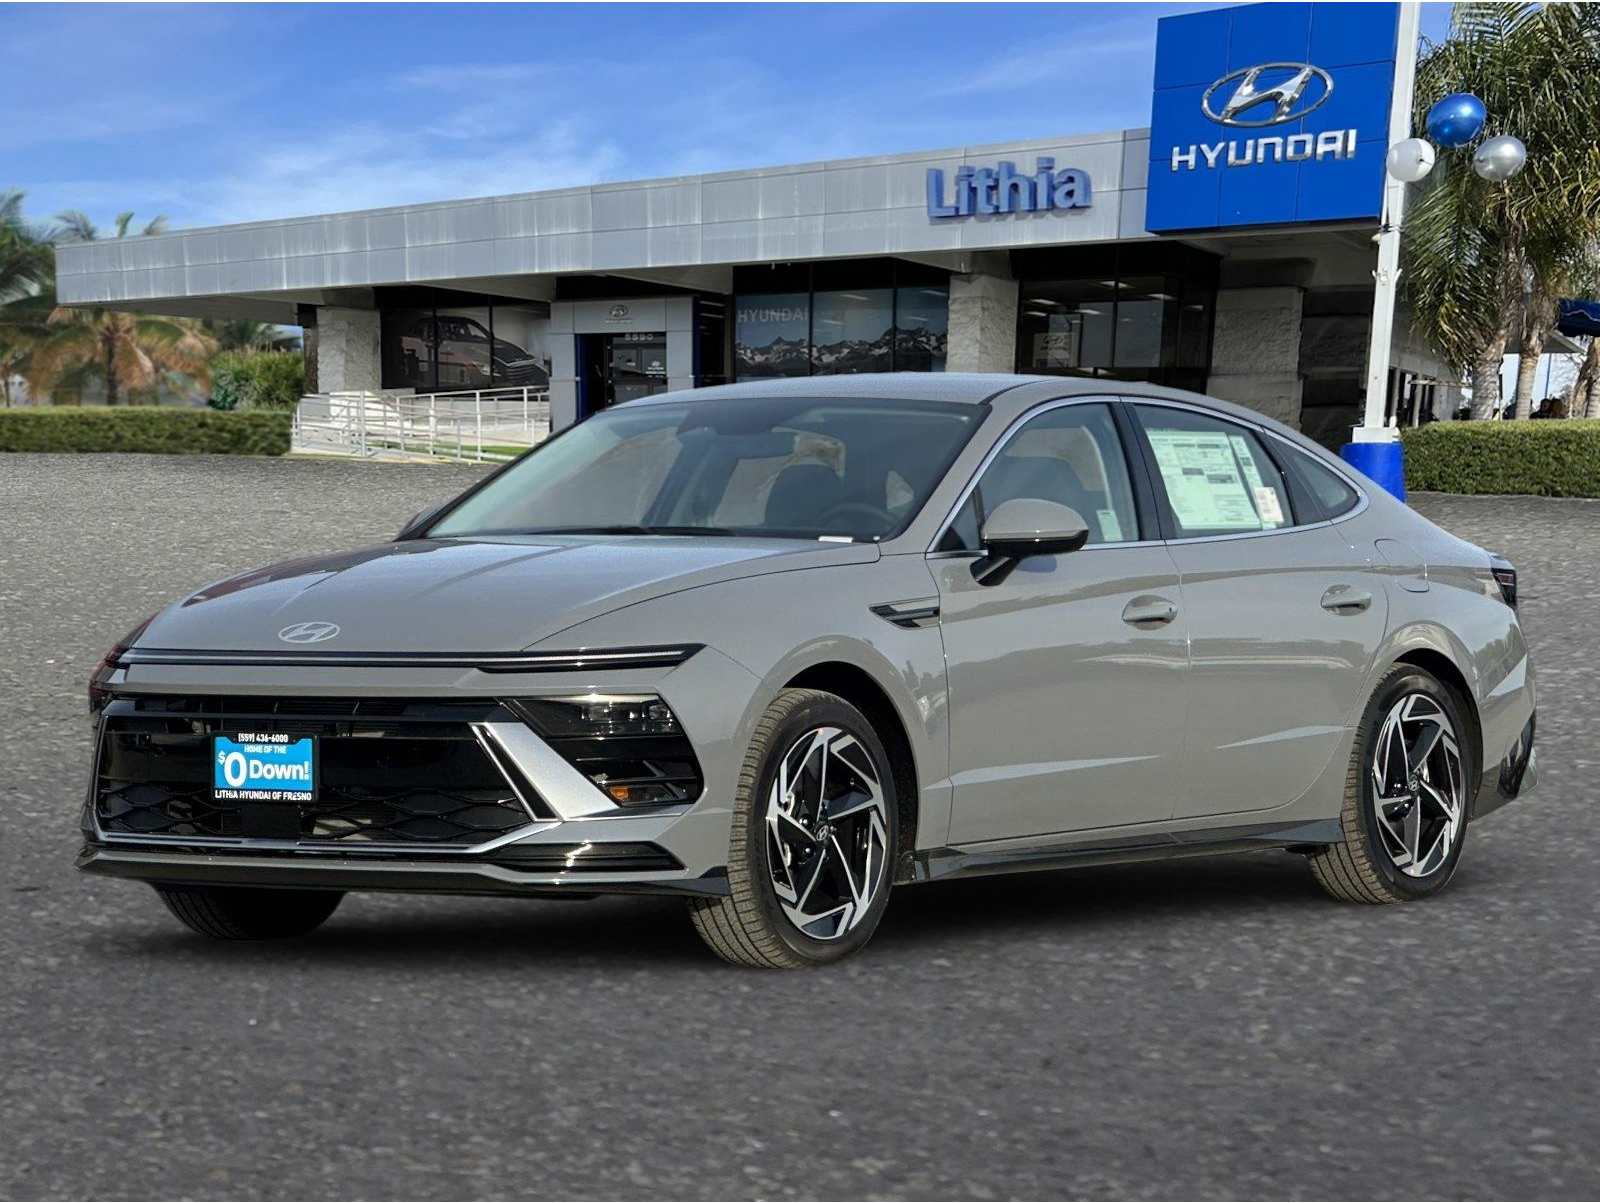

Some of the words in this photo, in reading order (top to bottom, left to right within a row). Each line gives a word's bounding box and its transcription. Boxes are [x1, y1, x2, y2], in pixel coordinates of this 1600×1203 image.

[1171, 129, 1357, 170] HYUNDAI
[926, 156, 1091, 220] Lithia
[737, 307, 807, 323] HYUNDAI
[256, 733, 288, 742] 436-6000
[244, 745, 262, 753] HOME
[264, 745, 272, 753] OF
[274, 745, 287, 754] THE
[249, 759, 309, 780] Down!
[215, 790, 238, 799] LITHIA
[239, 790, 270, 799] HYUNDAI
[272, 791, 282, 800] OF
[283, 791, 312, 801] FRESNO
